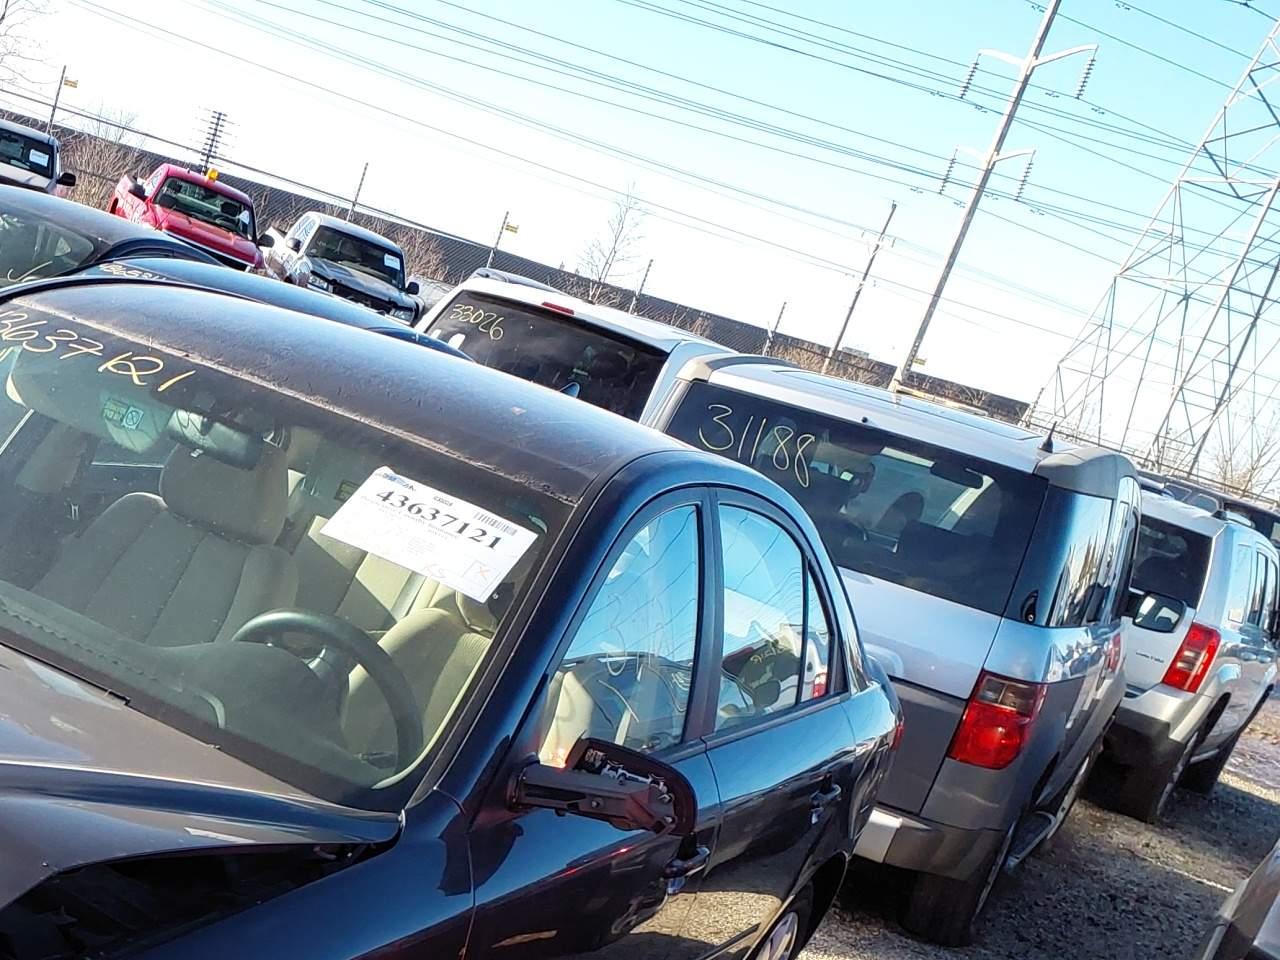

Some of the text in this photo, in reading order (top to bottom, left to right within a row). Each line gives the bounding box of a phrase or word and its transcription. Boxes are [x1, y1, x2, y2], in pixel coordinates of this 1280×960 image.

[449, 303, 505, 341] 33026
[698, 403, 816, 488] 31188
[375, 490, 502, 551] 43637121
